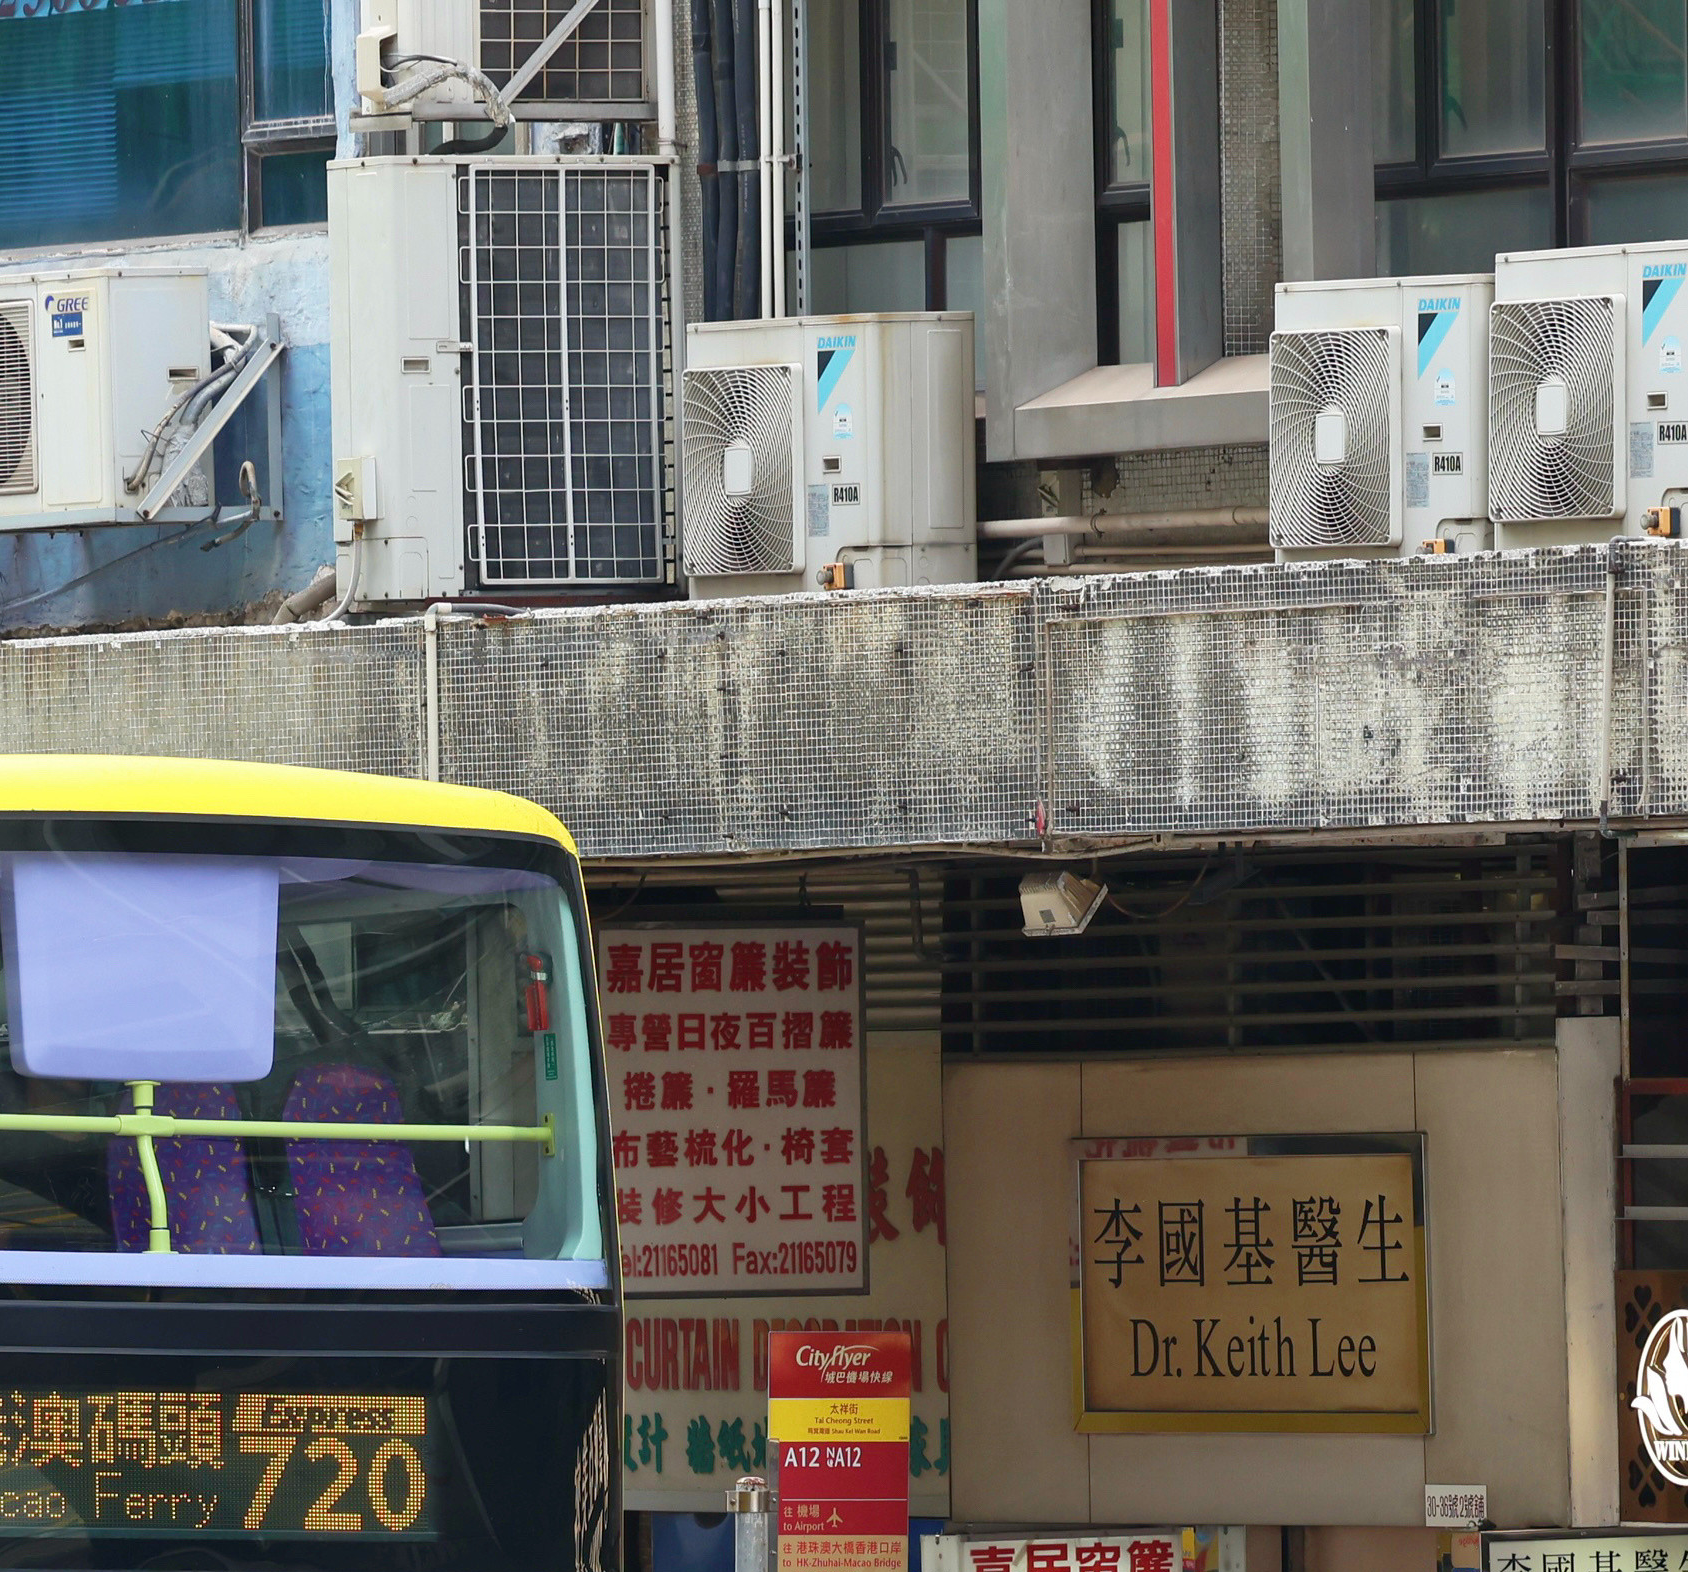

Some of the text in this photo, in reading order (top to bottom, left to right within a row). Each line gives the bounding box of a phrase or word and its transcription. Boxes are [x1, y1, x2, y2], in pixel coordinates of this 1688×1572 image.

[1643, 264, 1687, 278] DAIKIN
[57, 297, 89, 312] GREE
[1418, 298, 1461, 312] DAIKIN
[817, 336, 856, 349] DAIKIN
[1659, 424, 1687, 442] R410A
[1434, 455, 1461, 472] R410A
[833, 485, 858, 503] R410A
[1093, 1194, 1410, 1289] 李國基醫生
[621, 1240, 857, 1279] el:21165081 Fax:21165079
[626, 1318, 740, 1392] CURTAIN
[1129, 1315, 1377, 1379] Dr. Keith Lee
[796, 1345, 873, 1371] Cityflyer
[264, 1398, 394, 1435] Express
[830, 1403, 858, 1416] 太祥街
[815, 1417, 873, 1426] Tai Cheong Street
[784, 1447, 820, 1468] A12
[241, 1437, 426, 1532] 720
[94, 1472, 220, 1530] Ferry
[783, 1504, 820, 1519] 往 機場
[783, 1520, 825, 1533] to Airport
[782, 1541, 902, 1556] 往 港珠澳大橋香港口岸
[782, 1557, 902, 1570] to HK-Zhuhai-Macao Bridge
